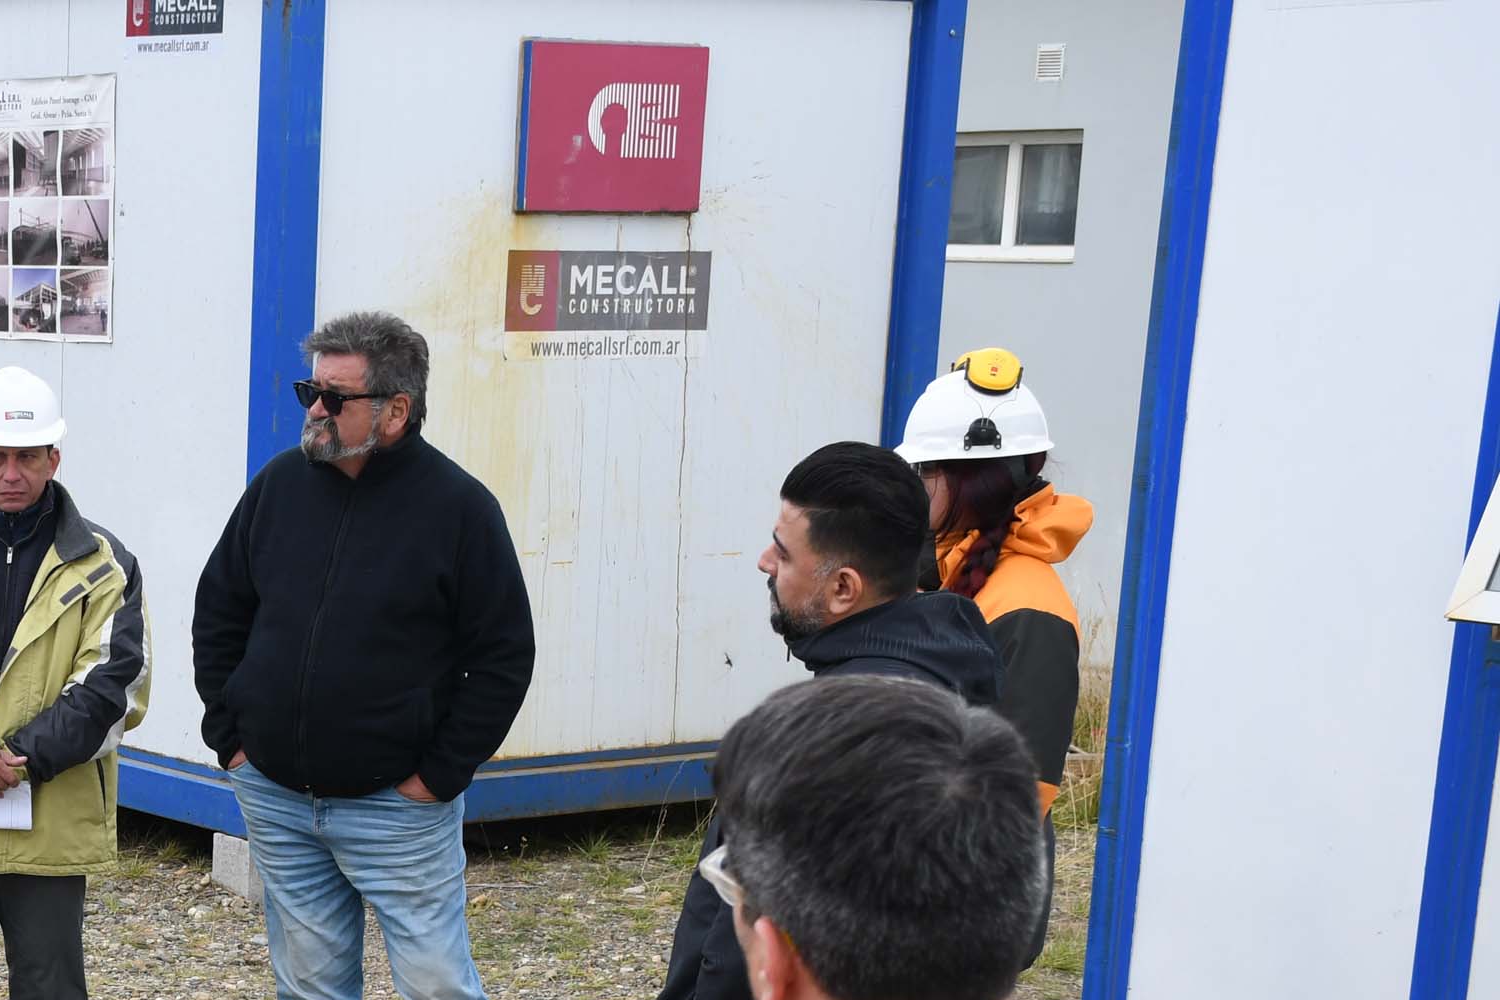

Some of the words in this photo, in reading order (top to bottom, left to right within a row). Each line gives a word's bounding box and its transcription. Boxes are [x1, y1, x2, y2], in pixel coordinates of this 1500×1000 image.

[154, 12, 218, 25] CONSTRUCTORA
[569, 264, 696, 296] MECALL
[568, 297, 695, 315] CONSTRUCTORA
[530, 335, 681, 357] www.mecallsrl.com.ar
